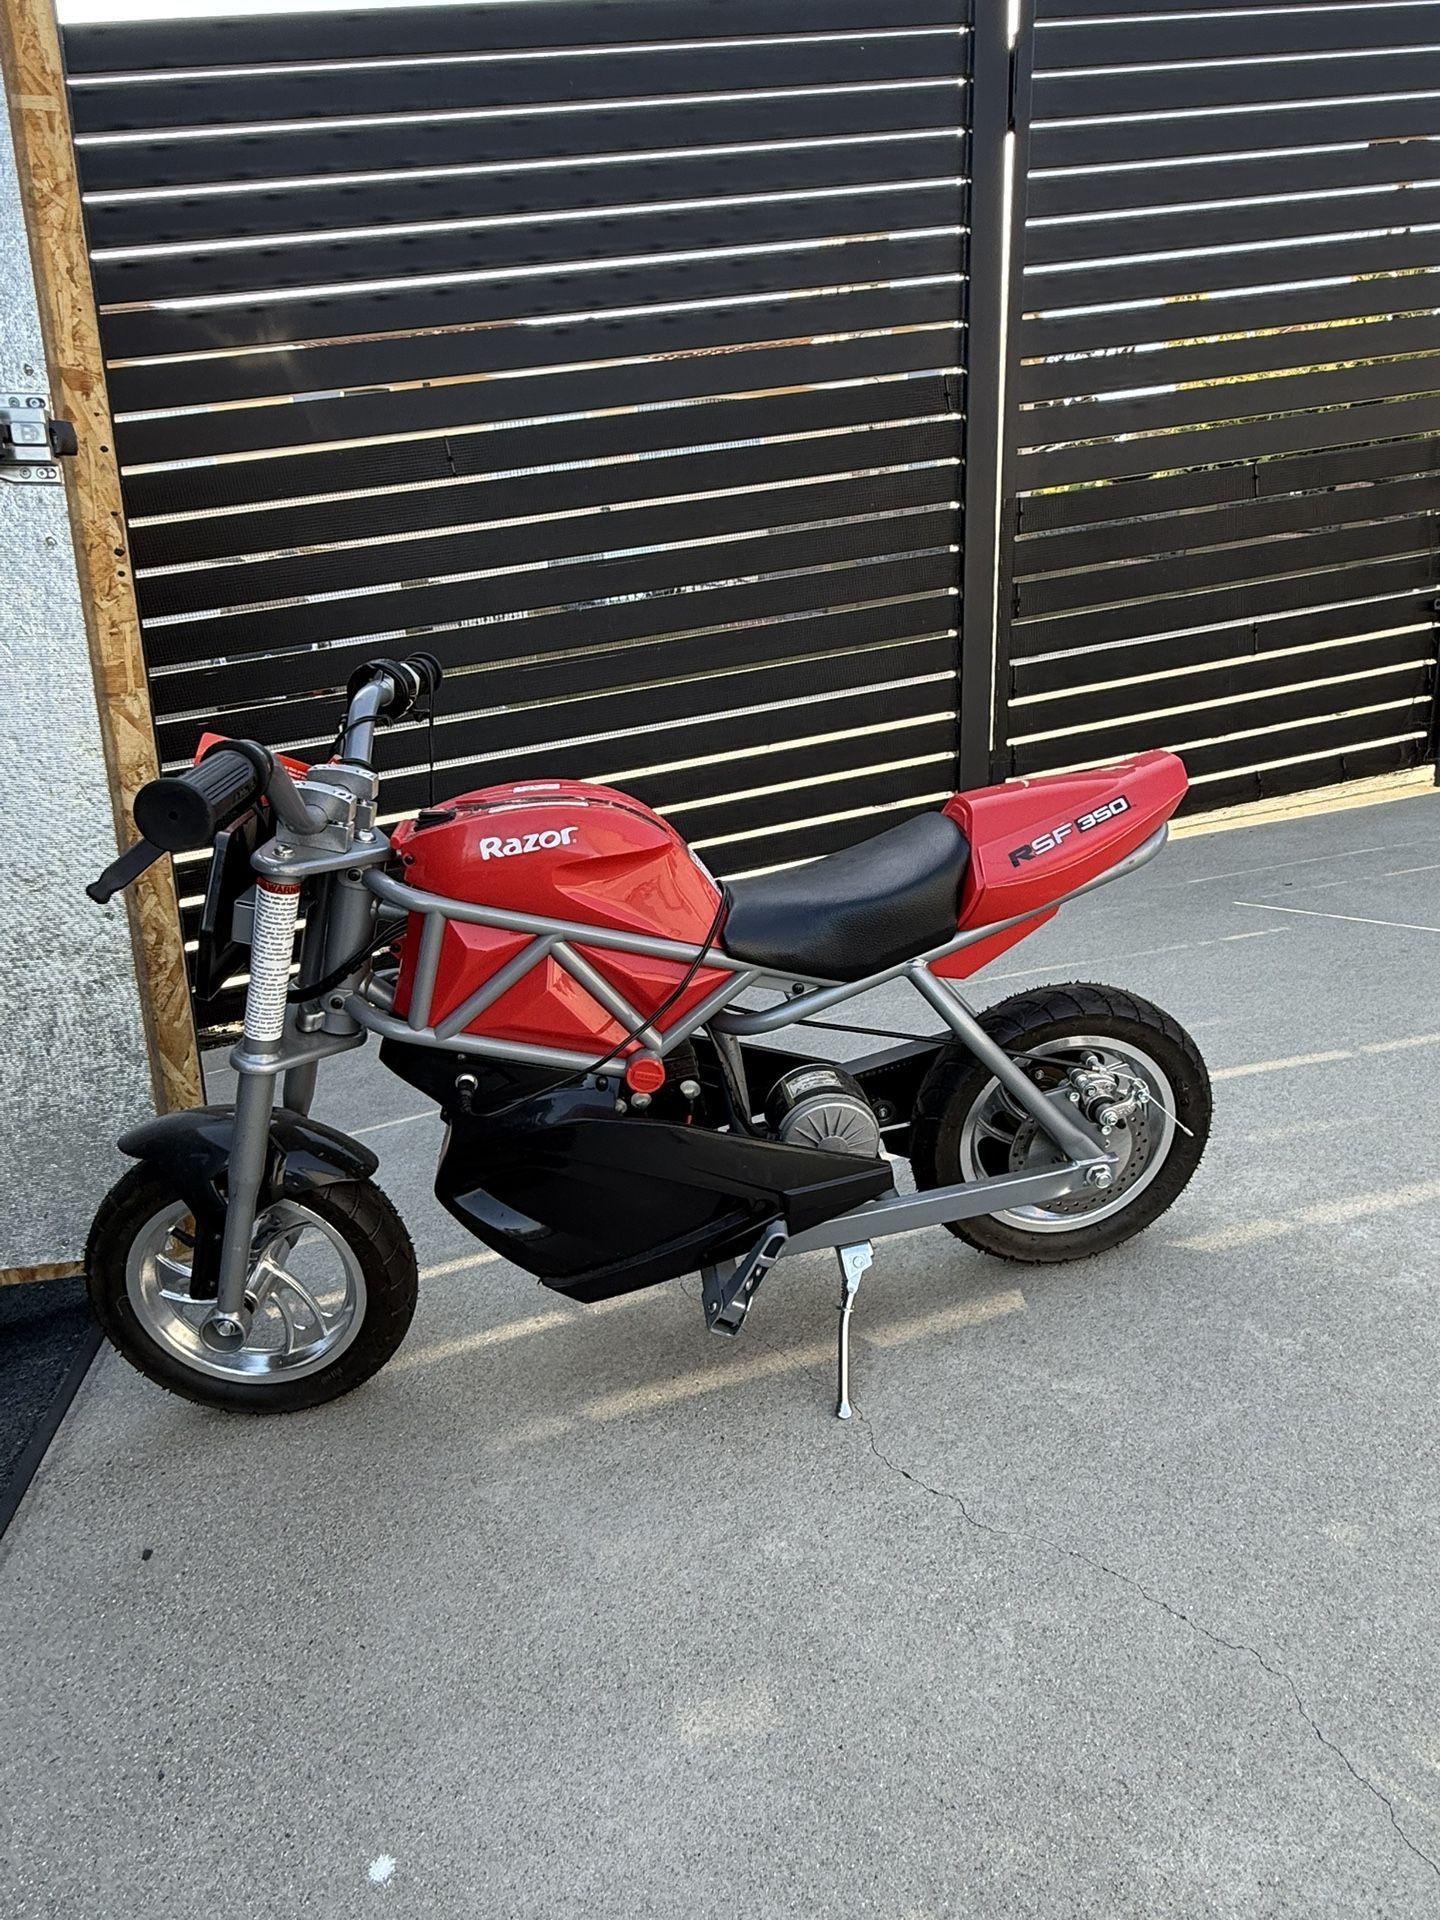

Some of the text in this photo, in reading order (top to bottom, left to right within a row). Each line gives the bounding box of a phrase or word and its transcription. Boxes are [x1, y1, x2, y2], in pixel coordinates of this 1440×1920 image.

[479, 826, 579, 861] Razor
[1008, 796, 1130, 868] RSF 350
